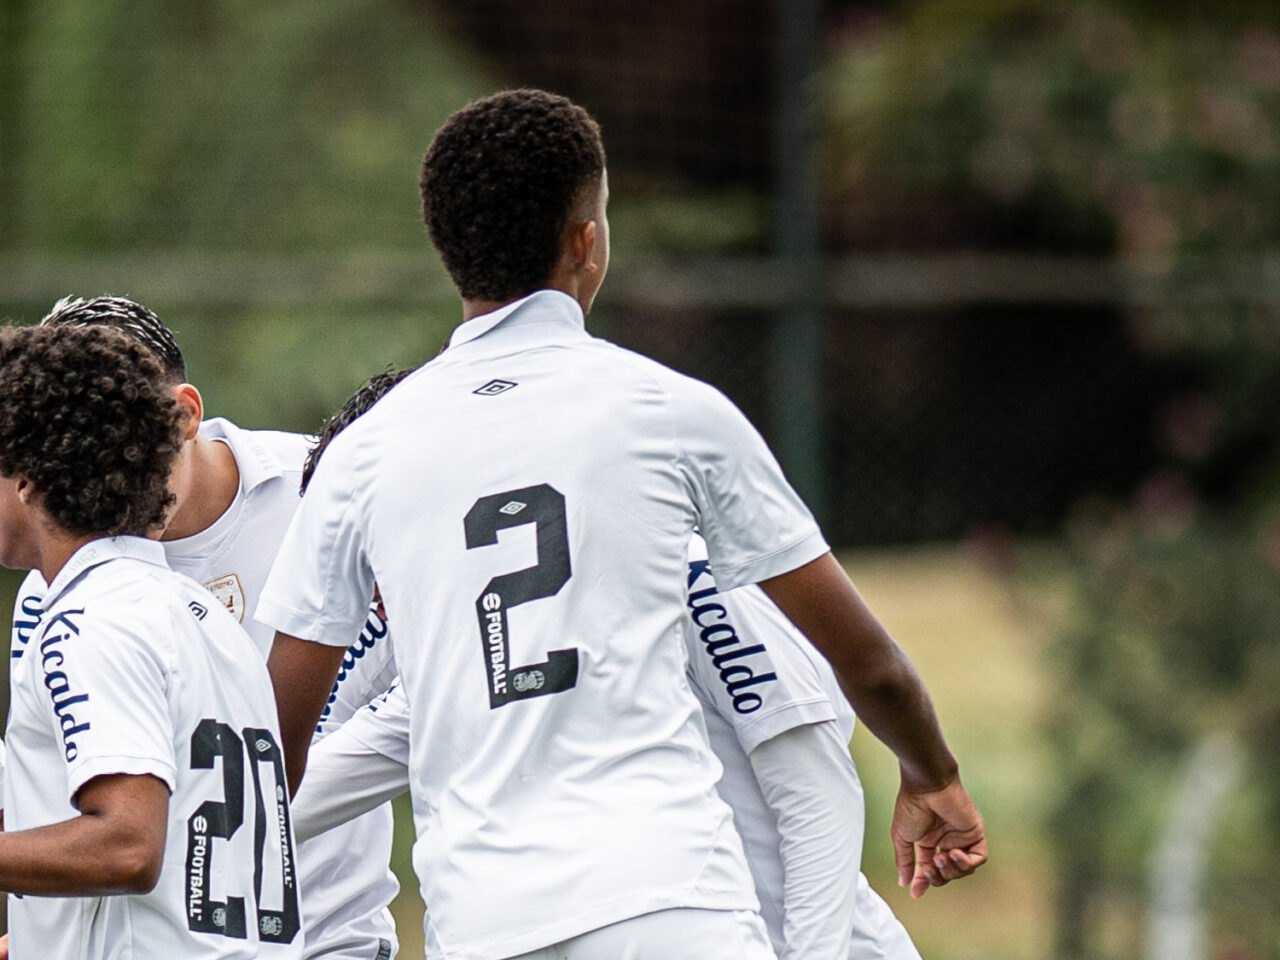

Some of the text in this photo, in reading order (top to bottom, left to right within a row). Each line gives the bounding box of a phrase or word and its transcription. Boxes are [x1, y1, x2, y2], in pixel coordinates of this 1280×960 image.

[40, 607, 91, 763] Kicaldo
[463, 483, 579, 710] 2
[186, 718, 304, 945] 20
